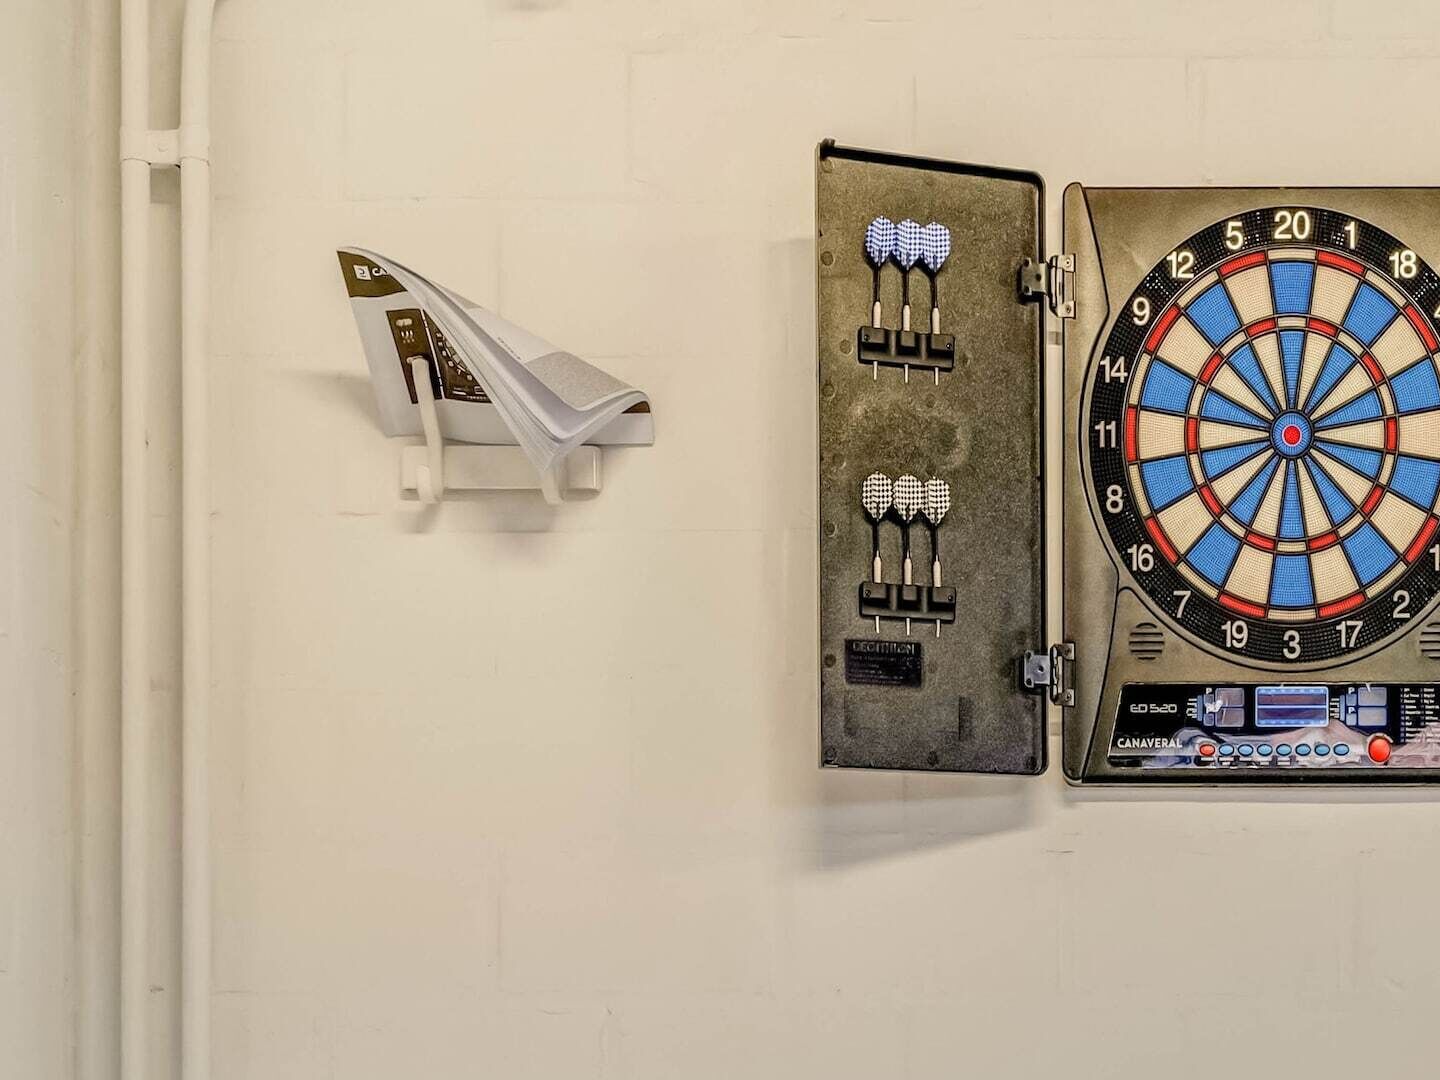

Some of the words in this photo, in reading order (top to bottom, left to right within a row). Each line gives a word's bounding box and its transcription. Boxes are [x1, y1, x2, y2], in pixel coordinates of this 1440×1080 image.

[1226, 221, 1243, 250] 5
[1274, 211, 1310, 240] 20
[1345, 221, 1356, 249] 1
[1168, 251, 1194, 279] 12
[1389, 251, 1416, 279] 18
[1133, 297, 1150, 325] 9
[1100, 357, 1128, 383] 14
[1095, 421, 1117, 447] 11
[1106, 485, 1123, 513] 8
[1128, 545, 1154, 572] 16
[1174, 591, 1191, 617] 7
[1393, 590, 1410, 618] 2
[1223, 621, 1248, 649] 19
[1283, 631, 1300, 659] 3
[1336, 621, 1363, 648] 17
[1149, 703, 1178, 713] 520
[1116, 737, 1183, 749] CANAVERAL
